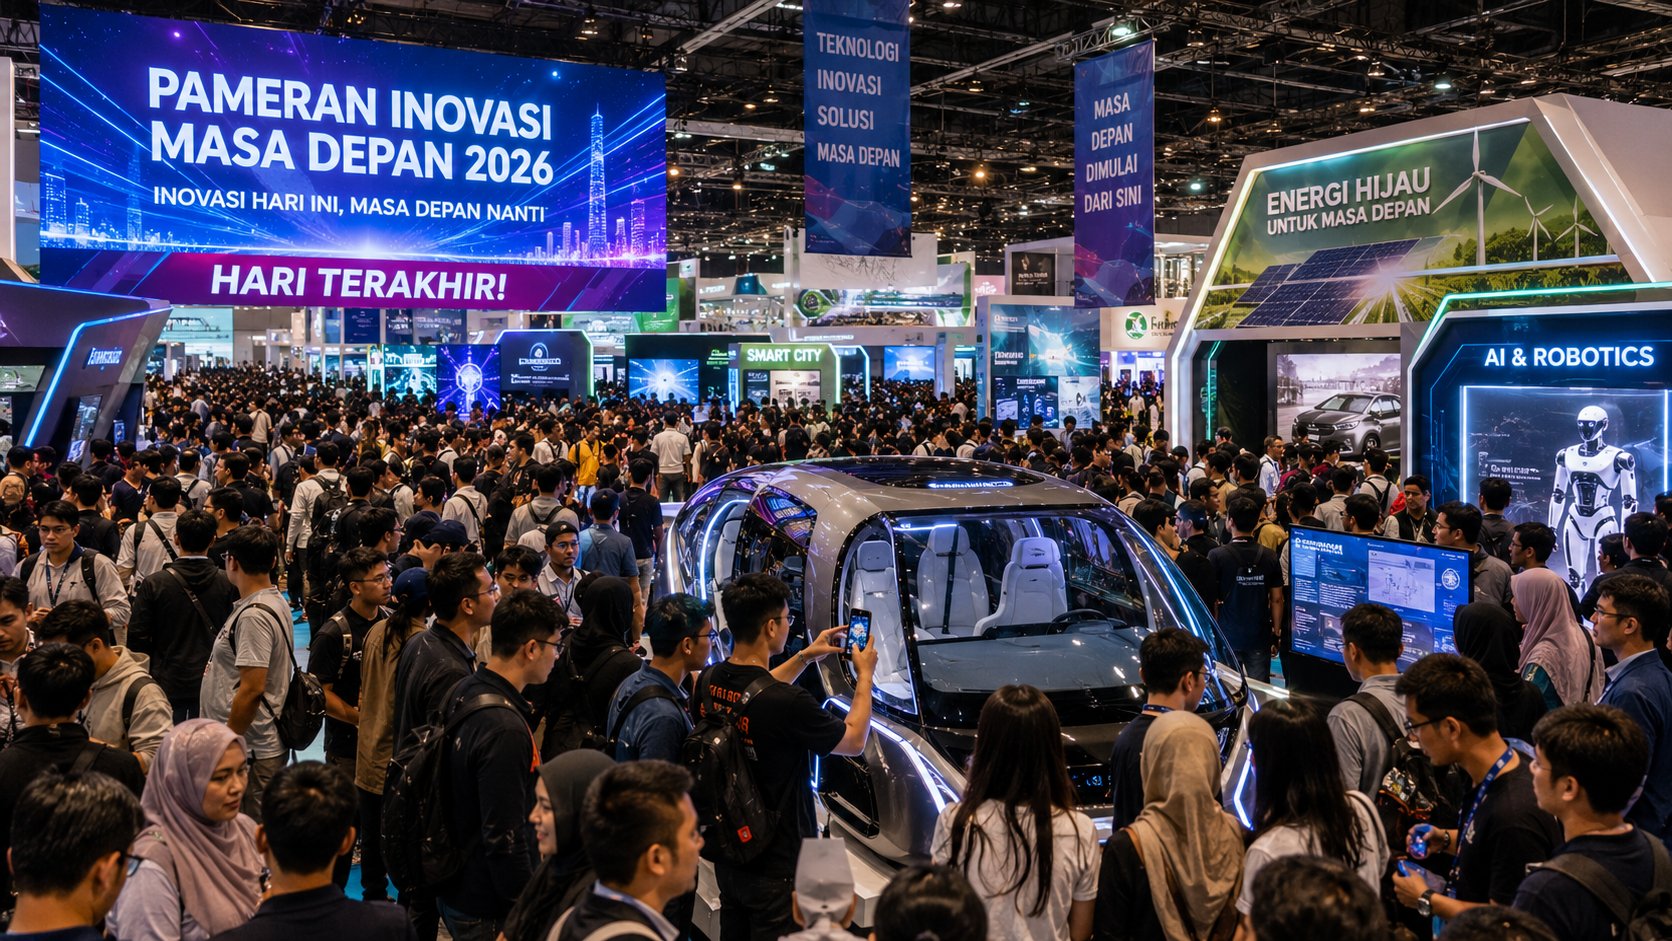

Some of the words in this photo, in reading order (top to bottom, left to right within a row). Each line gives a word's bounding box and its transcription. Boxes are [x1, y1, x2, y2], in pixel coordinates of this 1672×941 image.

[816, 32, 899, 62] TEKNOLOGI
[817, 69, 881, 96] INOVASI
[149, 66, 377, 127] PAMERAN
[391, 90, 551, 141] INOVASI
[817, 105, 874, 130] SOLUSI
[1094, 91, 1131, 120] MASA
[1091, 122, 1133, 151] DEPAN
[151, 119, 296, 170] MASA
[308, 130, 454, 180] DEPAN
[465, 144, 554, 186] 2026
[817, 142, 855, 164] MASA
[858, 146, 900, 168] DEPAN
[1086, 152, 1138, 183] DIMULAI
[153, 186, 245, 209] INOVASI
[252, 191, 304, 212] HARI
[310, 194, 344, 217] INI,
[350, 196, 410, 217] MASA
[415, 200, 481, 220] DEPAN
[487, 203, 545, 223] NANTI
[1084, 190, 1113, 214] DARI
[1115, 184, 1142, 208] SINI
[1267, 180, 1349, 215] ENERGI
[1355, 166, 1430, 203] HIJAU
[1267, 213, 1318, 236] UNTUK
[1320, 205, 1368, 228] MASA
[1372, 195, 1430, 222] DEPAN
[211, 264, 307, 296] HARI
[317, 268, 507, 301] TERAKHIR!
[746, 348, 791, 362] SMART
[794, 348, 823, 362] CITY
[1484, 348, 1505, 366] AI
[1511, 348, 1527, 366] &
[1534, 346, 1654, 367] ROBOTICS
